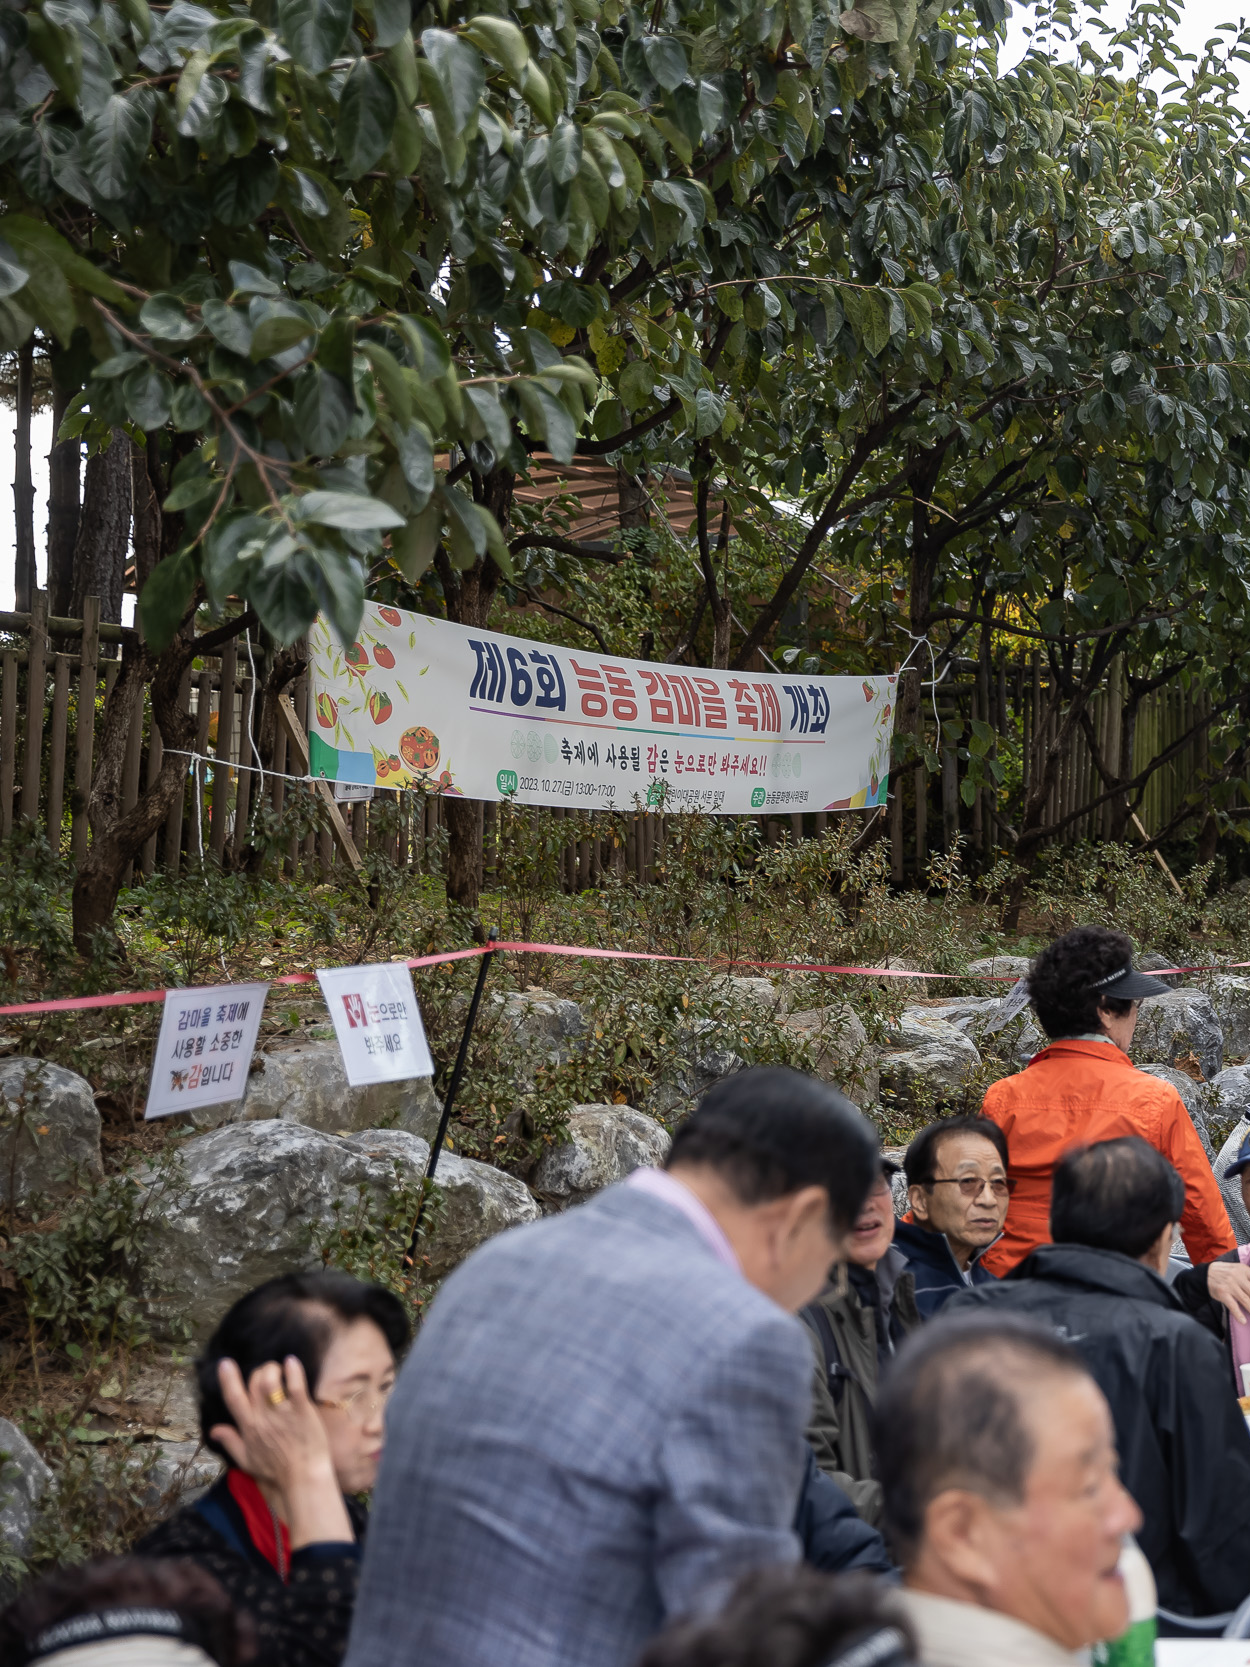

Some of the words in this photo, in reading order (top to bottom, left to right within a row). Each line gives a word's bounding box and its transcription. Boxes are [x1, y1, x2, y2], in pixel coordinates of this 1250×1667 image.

[467, 639, 567, 712] 제6회
[569, 658, 638, 722] 능동
[636, 669, 728, 730] 감마을
[726, 677, 782, 733] 축제
[782, 684, 831, 734] 개최
[561, 737, 600, 767] 축제에
[605, 743, 640, 772] 사용될
[646, 743, 669, 773] 감은
[674, 749, 717, 776] 눈으로만
[720, 751, 768, 777] 봐주세요!!
[500, 773, 516, 791] 일시
[519, 776, 539, 791] 2023.
[575, 782, 616, 797] 13:00~17:00
[753, 791, 765, 805] 주관
[178, 1007, 211, 1031] 감마을
[216, 1001, 250, 1024] 축제에
[367, 1001, 408, 1023] 눈으로만
[171, 1035, 206, 1059] 사용할
[209, 1029, 243, 1052] 소중한
[364, 1033, 403, 1055] 봐주세요
[188, 1062, 233, 1089] 감입니다
